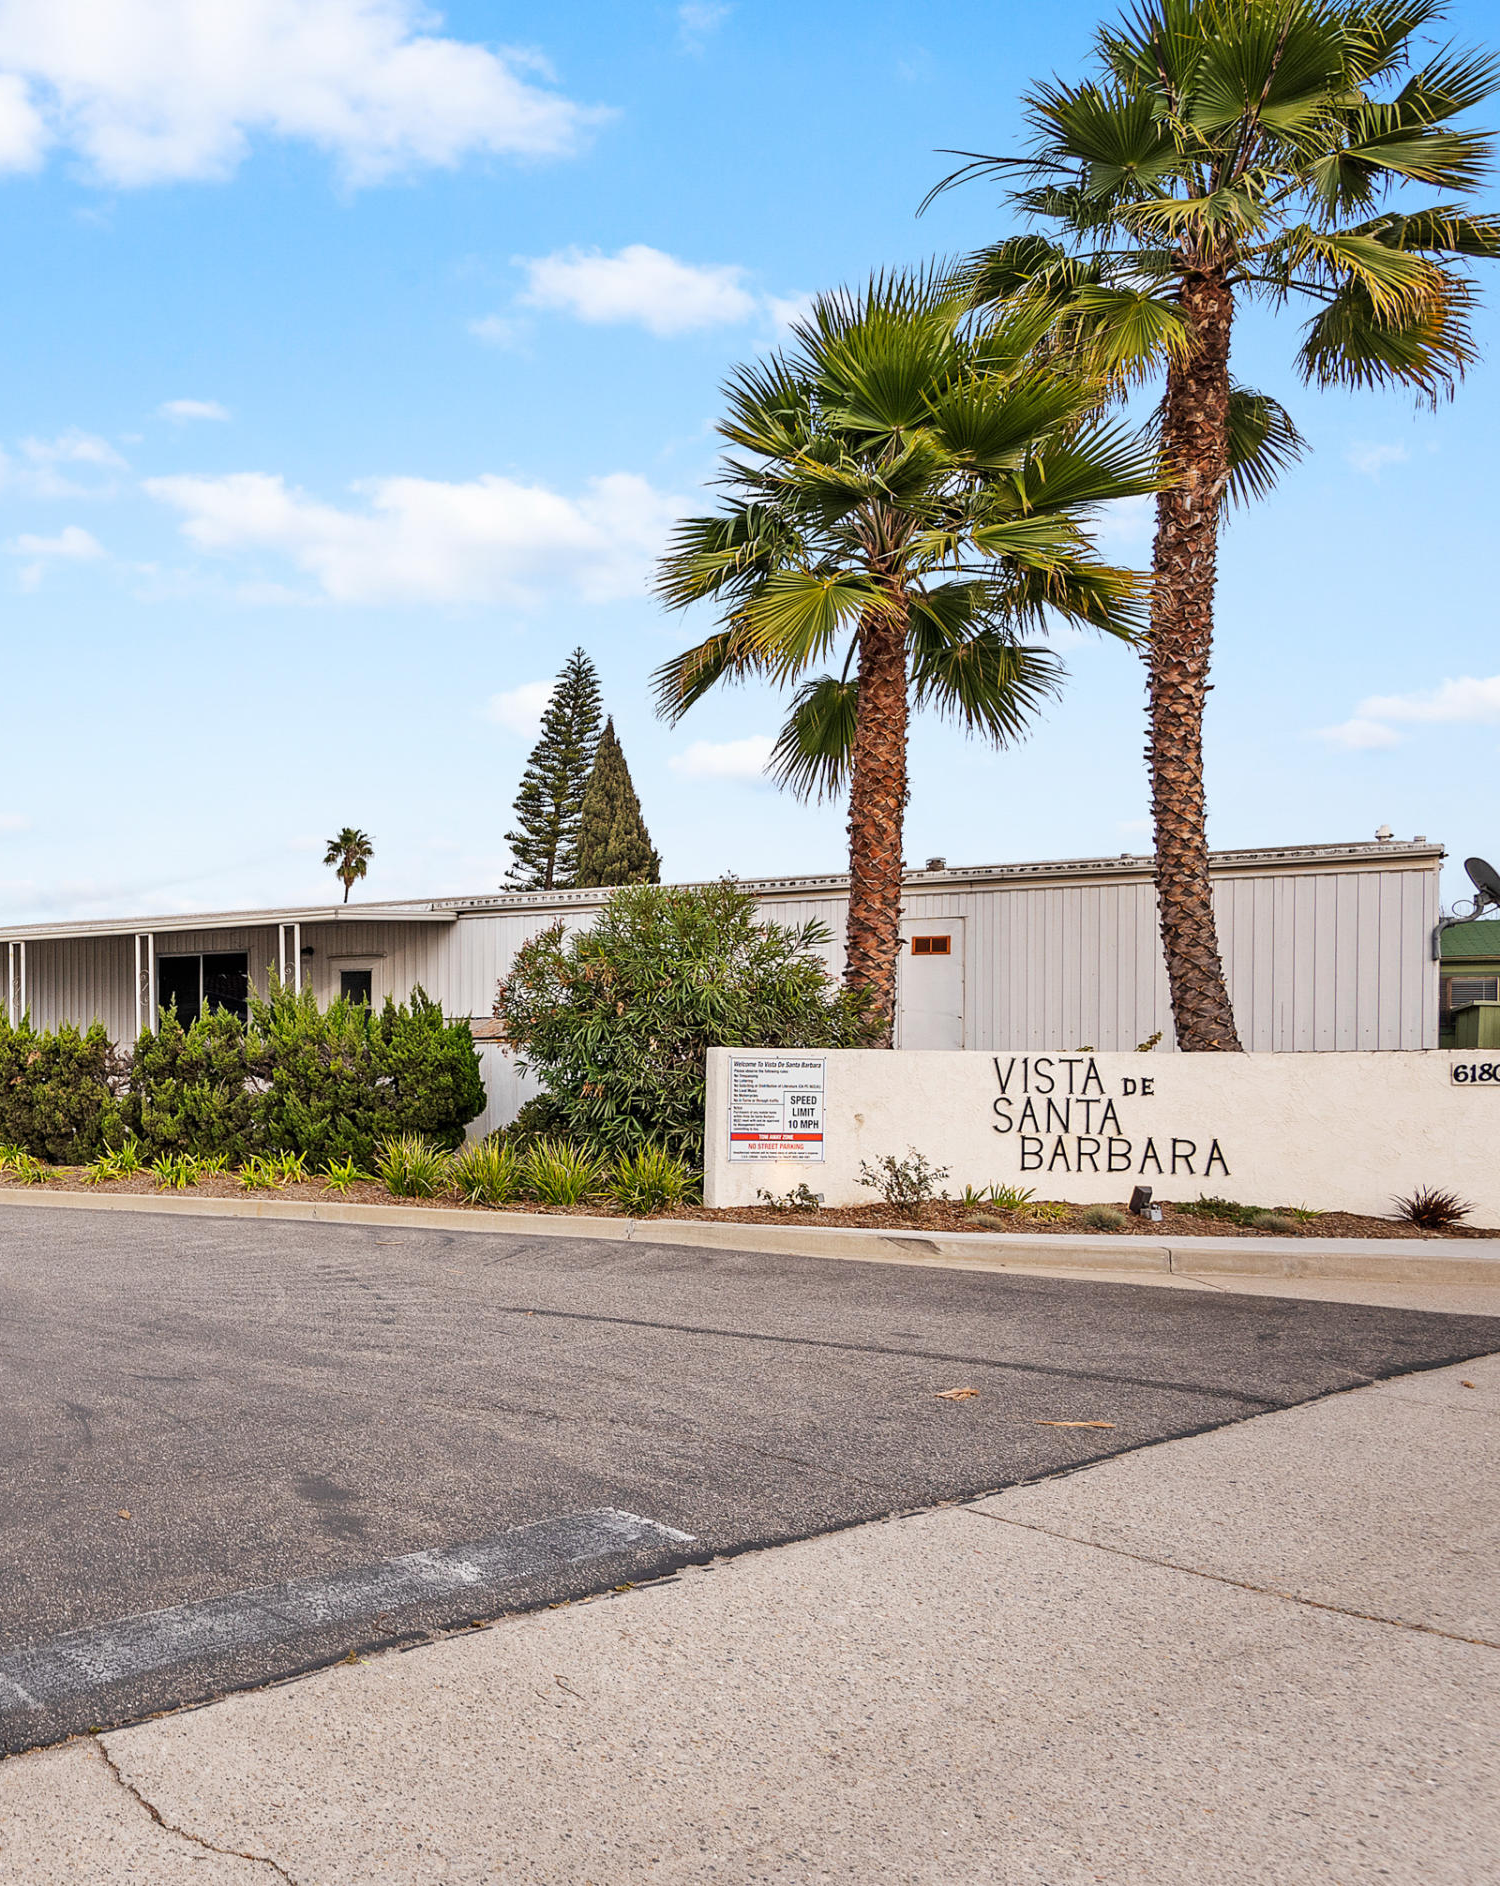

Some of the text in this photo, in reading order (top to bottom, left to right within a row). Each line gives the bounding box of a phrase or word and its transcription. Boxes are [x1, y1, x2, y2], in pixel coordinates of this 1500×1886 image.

[992, 1057, 1155, 1096] VISTA DE
[790, 1096, 817, 1105] SPEED
[792, 1108, 815, 1117] LIMIT
[788, 1120, 798, 1129] 10
[800, 1120, 819, 1129] MPH
[992, 1096, 1123, 1135] SANTA
[1020, 1135, 1232, 1177] BARBARA
